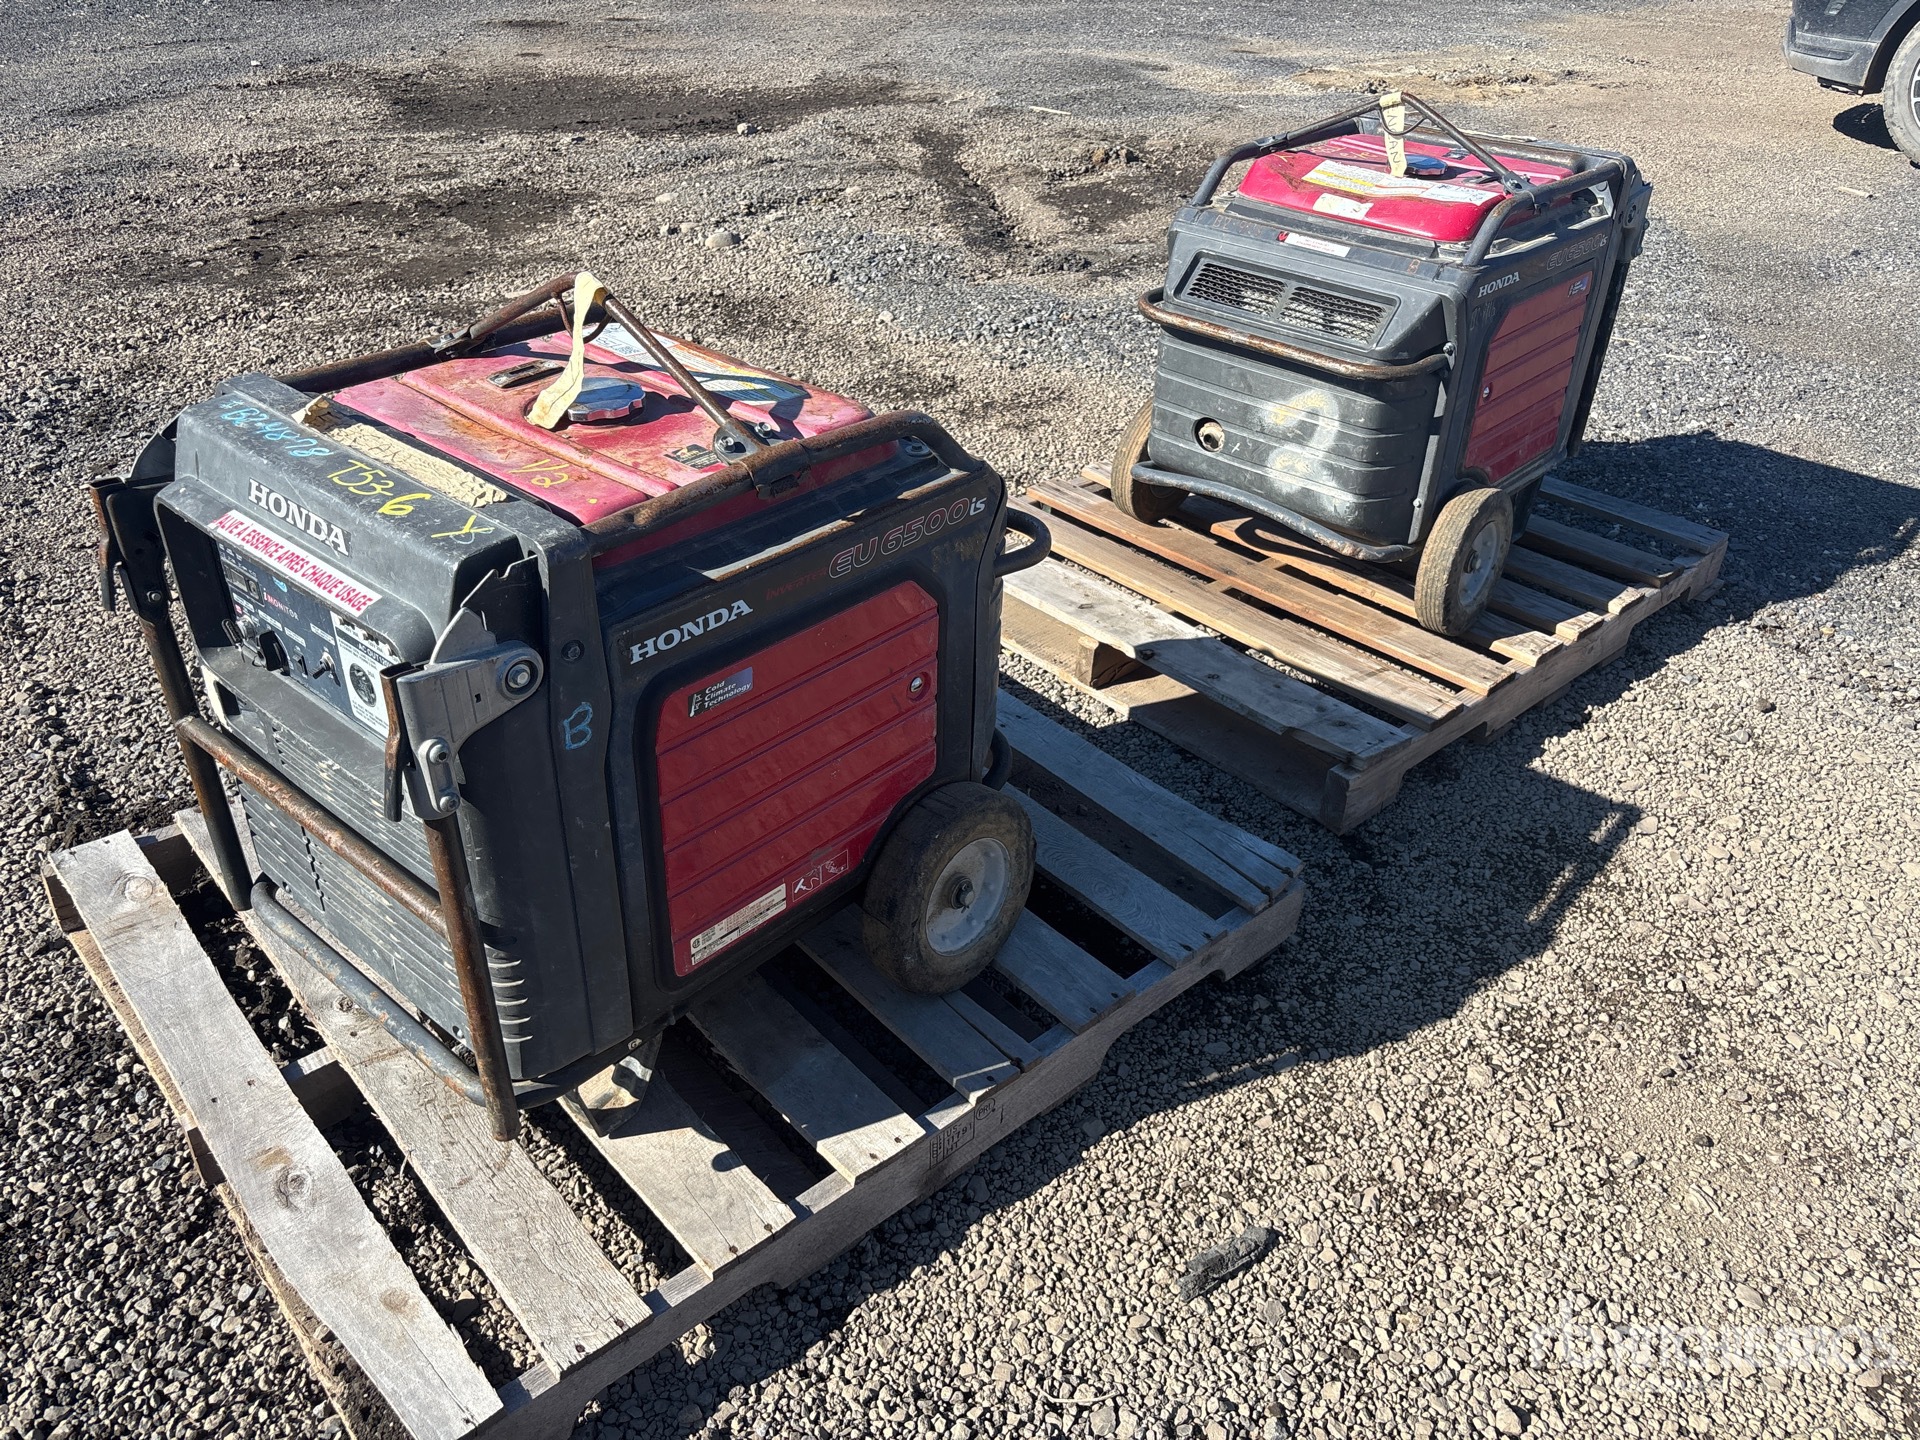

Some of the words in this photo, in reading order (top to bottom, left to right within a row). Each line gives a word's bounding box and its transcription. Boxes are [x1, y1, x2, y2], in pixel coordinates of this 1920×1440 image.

[1387, 115, 1401, 164] NAN
[1477, 271, 1521, 299] HONDA
[249, 478, 350, 556] HONDA
[241, 529, 286, 558] ESSENCE
[302, 562, 345, 594] CHAQUE
[335, 584, 375, 612] USAGE
[629, 599, 753, 665] HONDA
[704, 683, 737, 701] Climate
[704, 682, 752, 708] Technology
[705, 680, 725, 694] Cold
[563, 701, 594, 751] B
